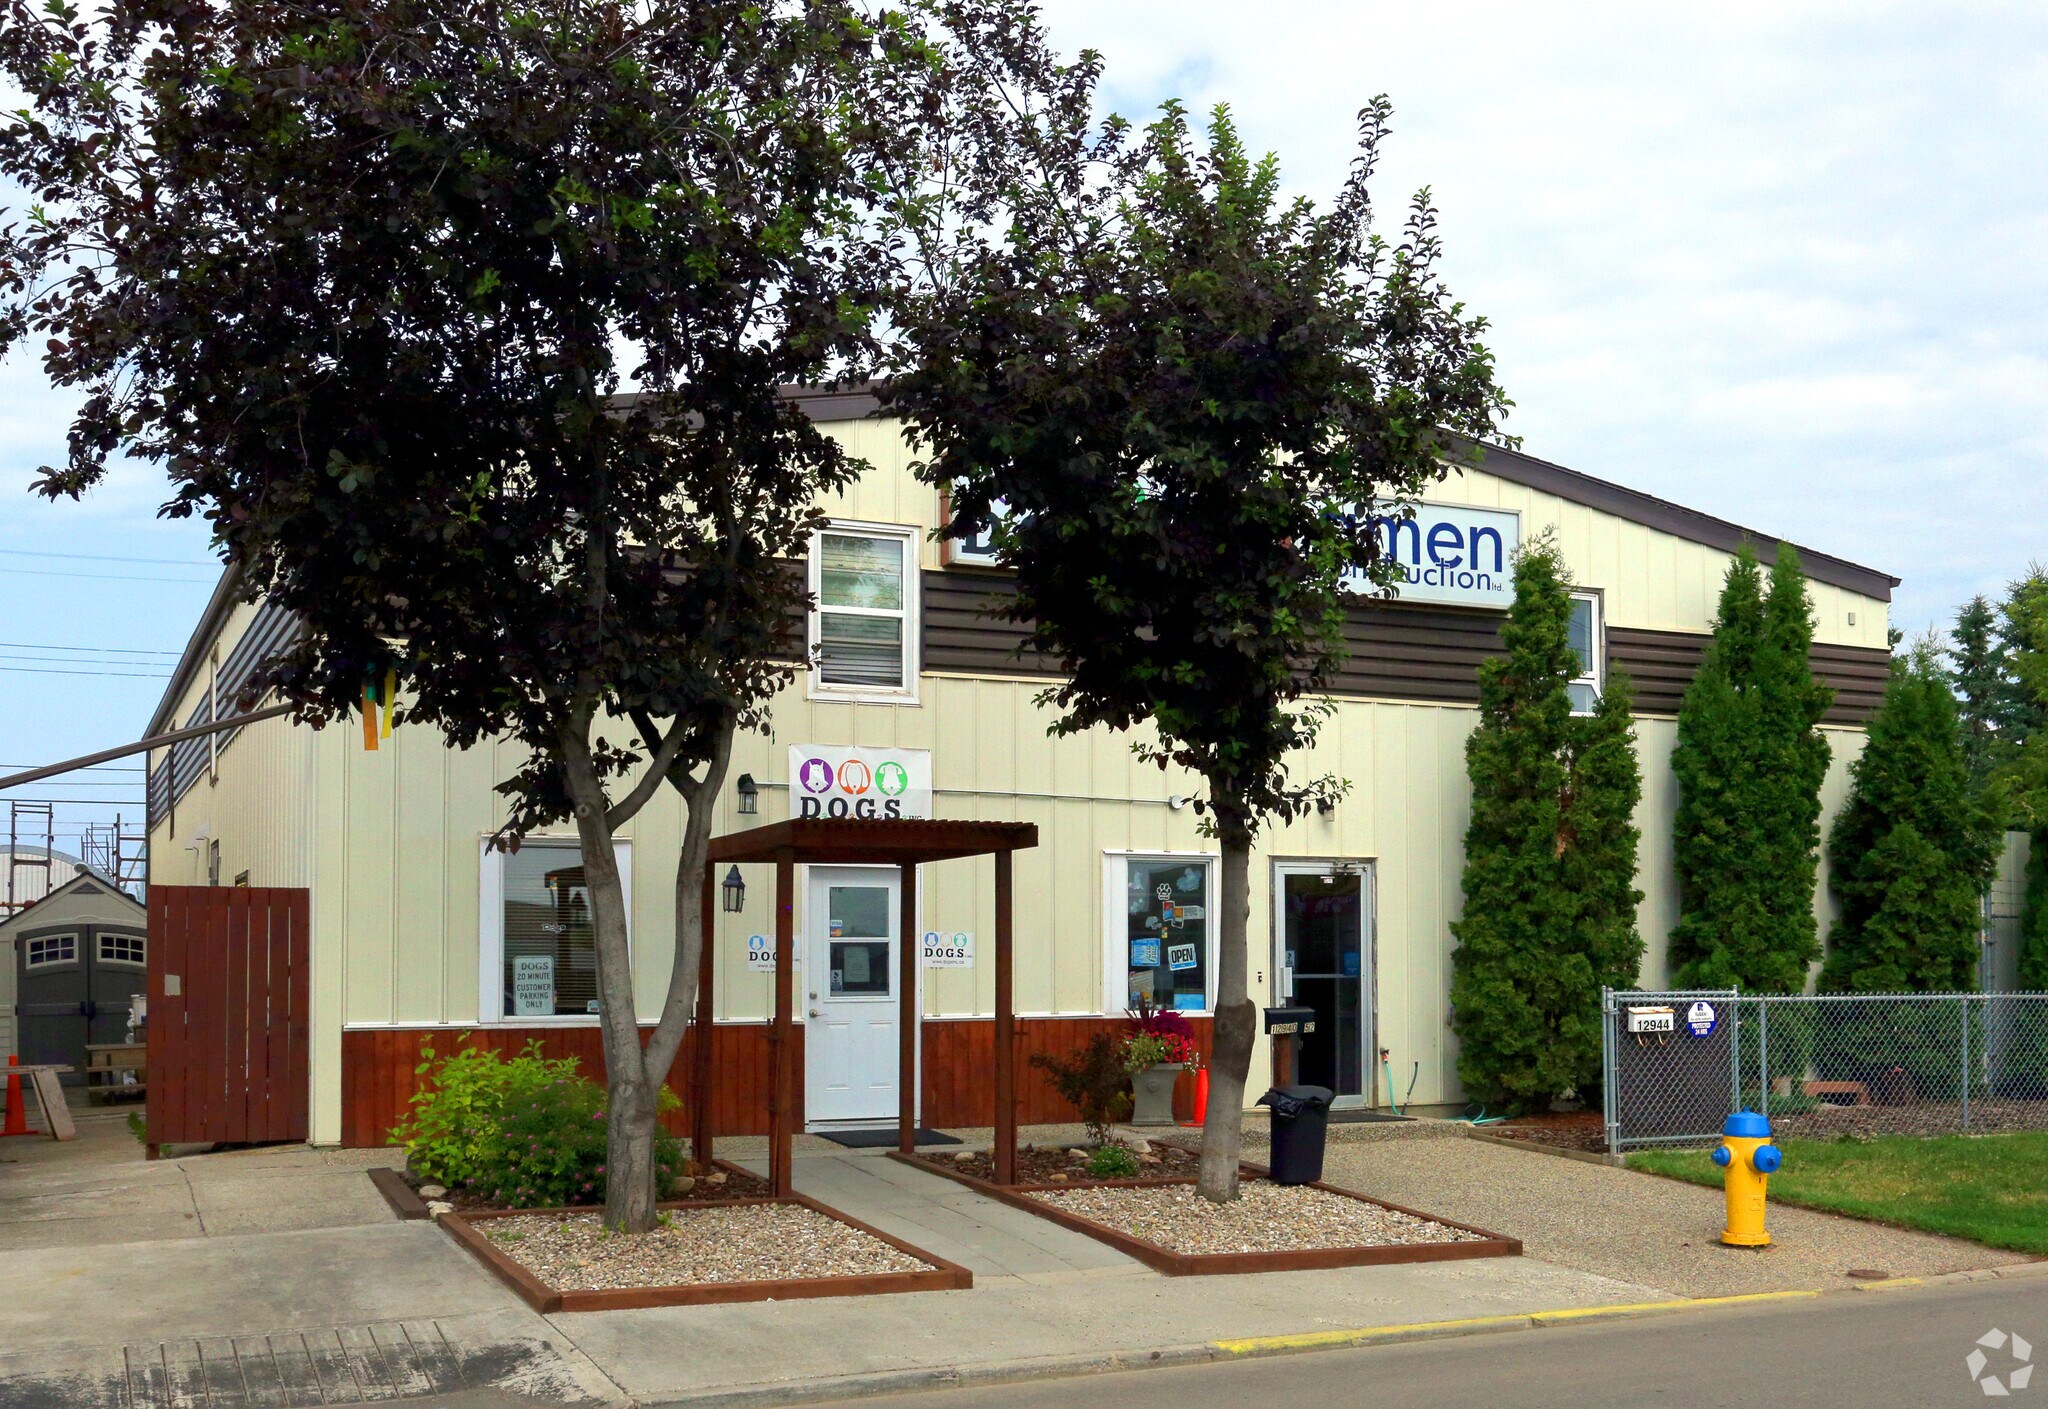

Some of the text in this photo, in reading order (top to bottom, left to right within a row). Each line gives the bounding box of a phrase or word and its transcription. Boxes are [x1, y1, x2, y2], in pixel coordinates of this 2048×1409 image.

[800, 796, 901, 820] DOGS
[924, 947, 964, 958] DOGS
[1171, 947, 1194, 963] OPEN
[521, 962, 549, 971] DOGS
[528, 972, 551, 980] MINUTE
[516, 983, 552, 991] CUSTOMER
[519, 992, 549, 1000] PARKING
[1637, 1019, 1670, 1031] 12944
